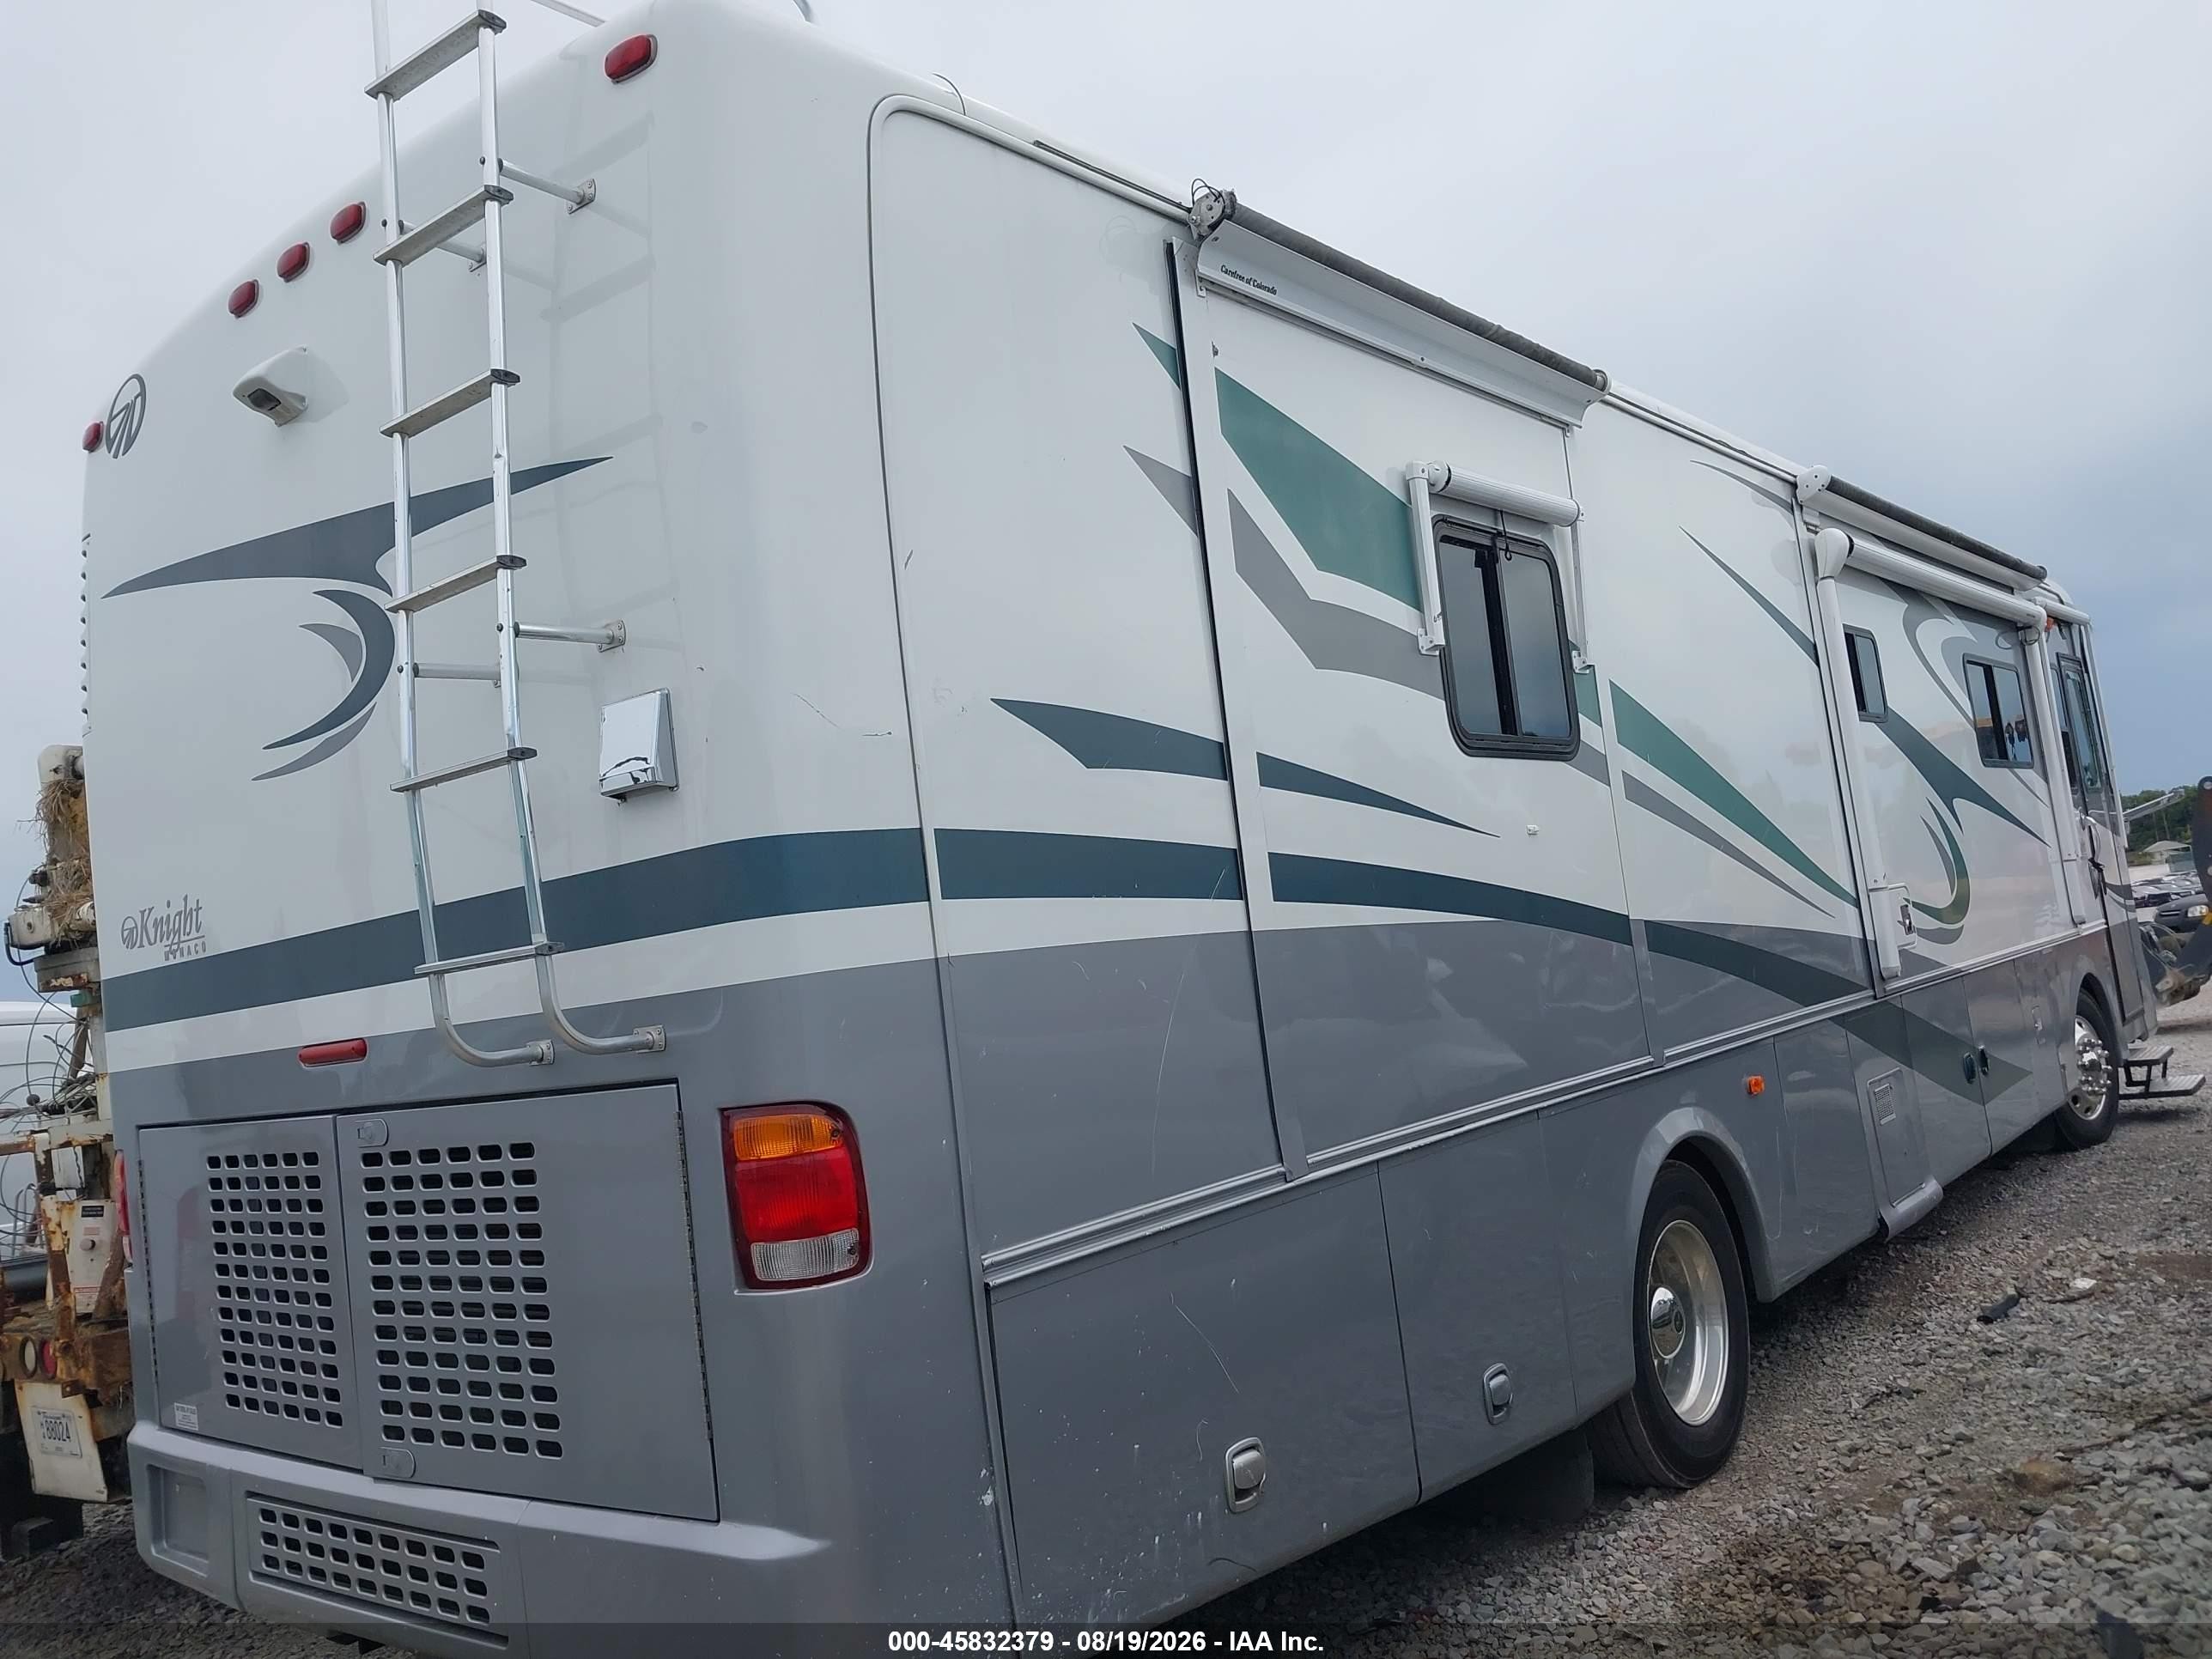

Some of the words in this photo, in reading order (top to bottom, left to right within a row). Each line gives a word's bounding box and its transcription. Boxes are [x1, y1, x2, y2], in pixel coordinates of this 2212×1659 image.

[1220, 264, 1245, 283] Carefree
[1245, 277, 1253, 286] of
[1252, 279, 1278, 295] Colorado
[137, 893, 203, 955] Knight
